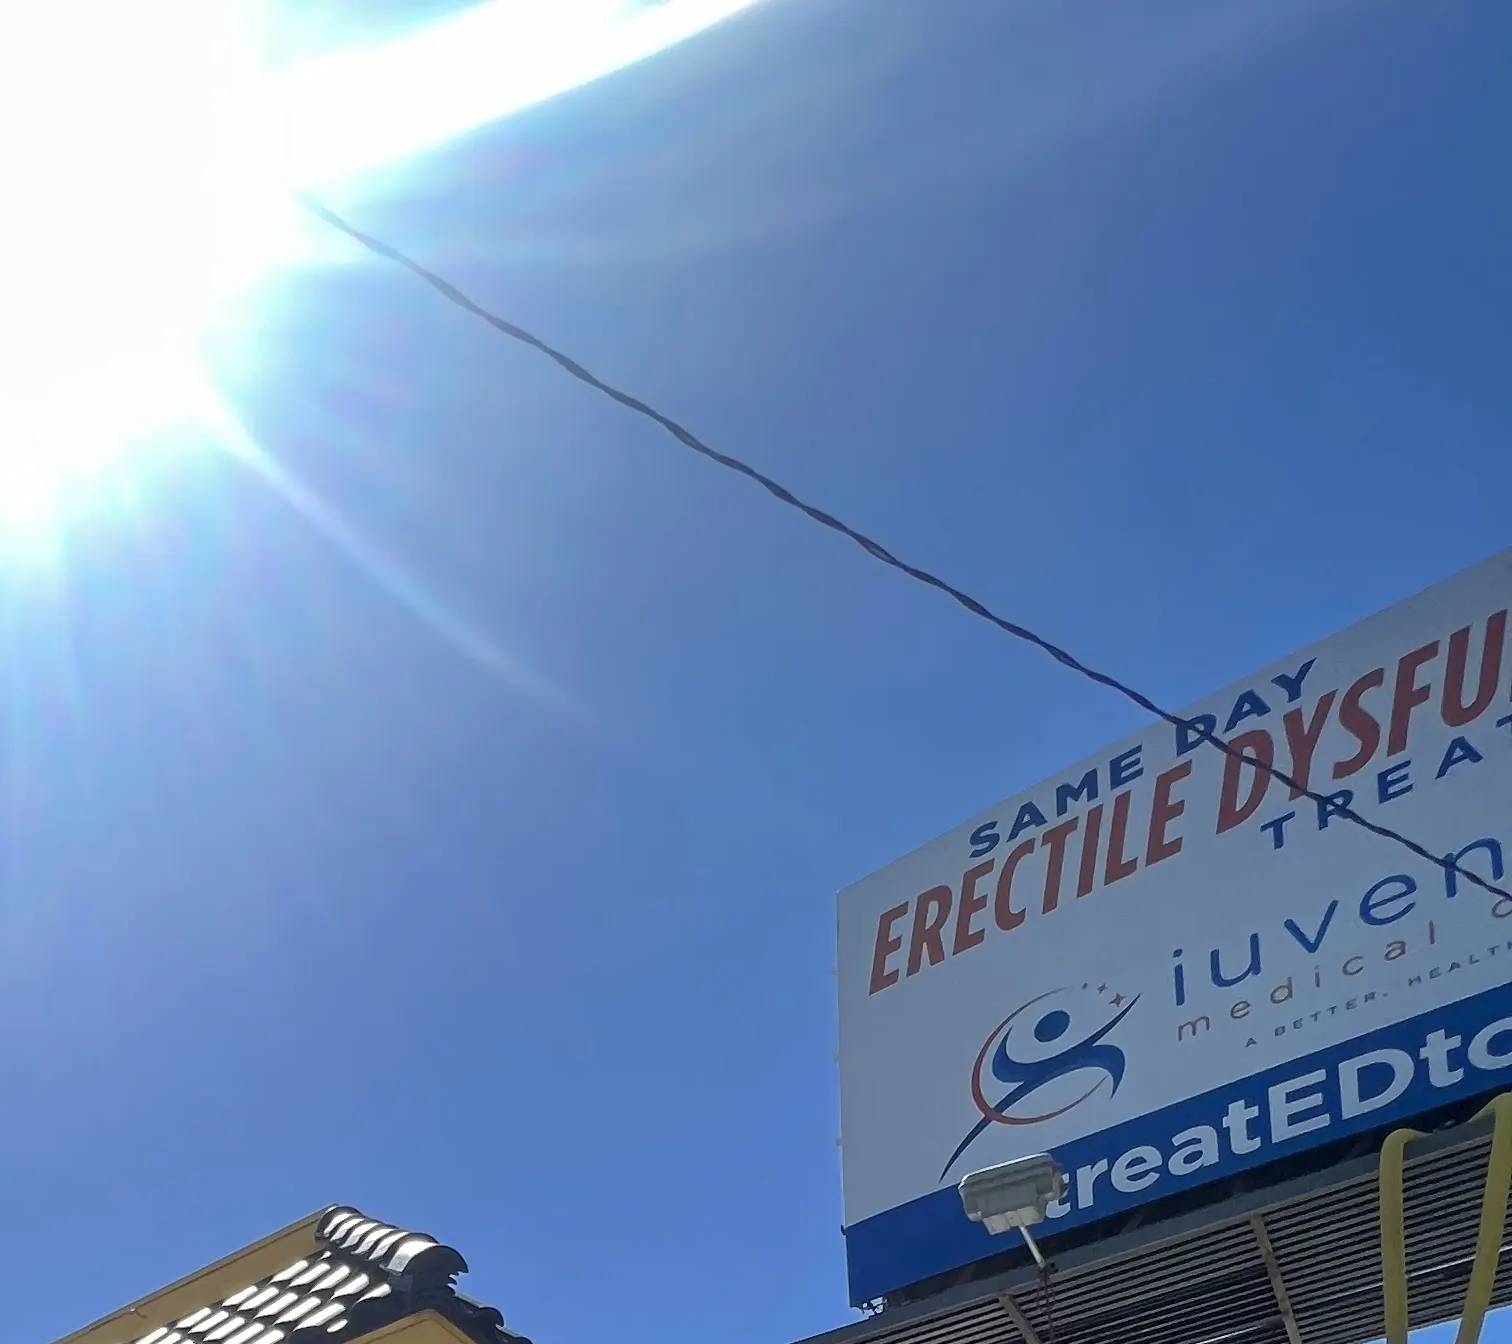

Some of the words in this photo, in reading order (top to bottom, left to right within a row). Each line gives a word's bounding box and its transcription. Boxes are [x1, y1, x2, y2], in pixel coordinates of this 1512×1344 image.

[868, 759, 1193, 997] ERECTILE
[1215, 608, 1512, 835] DYSFU
[969, 744, 1144, 858] SAME
[1175, 656, 1317, 758] DAY
[1177, 919, 1436, 1042] medical
[1244, 1037, 1258, 1048] A
